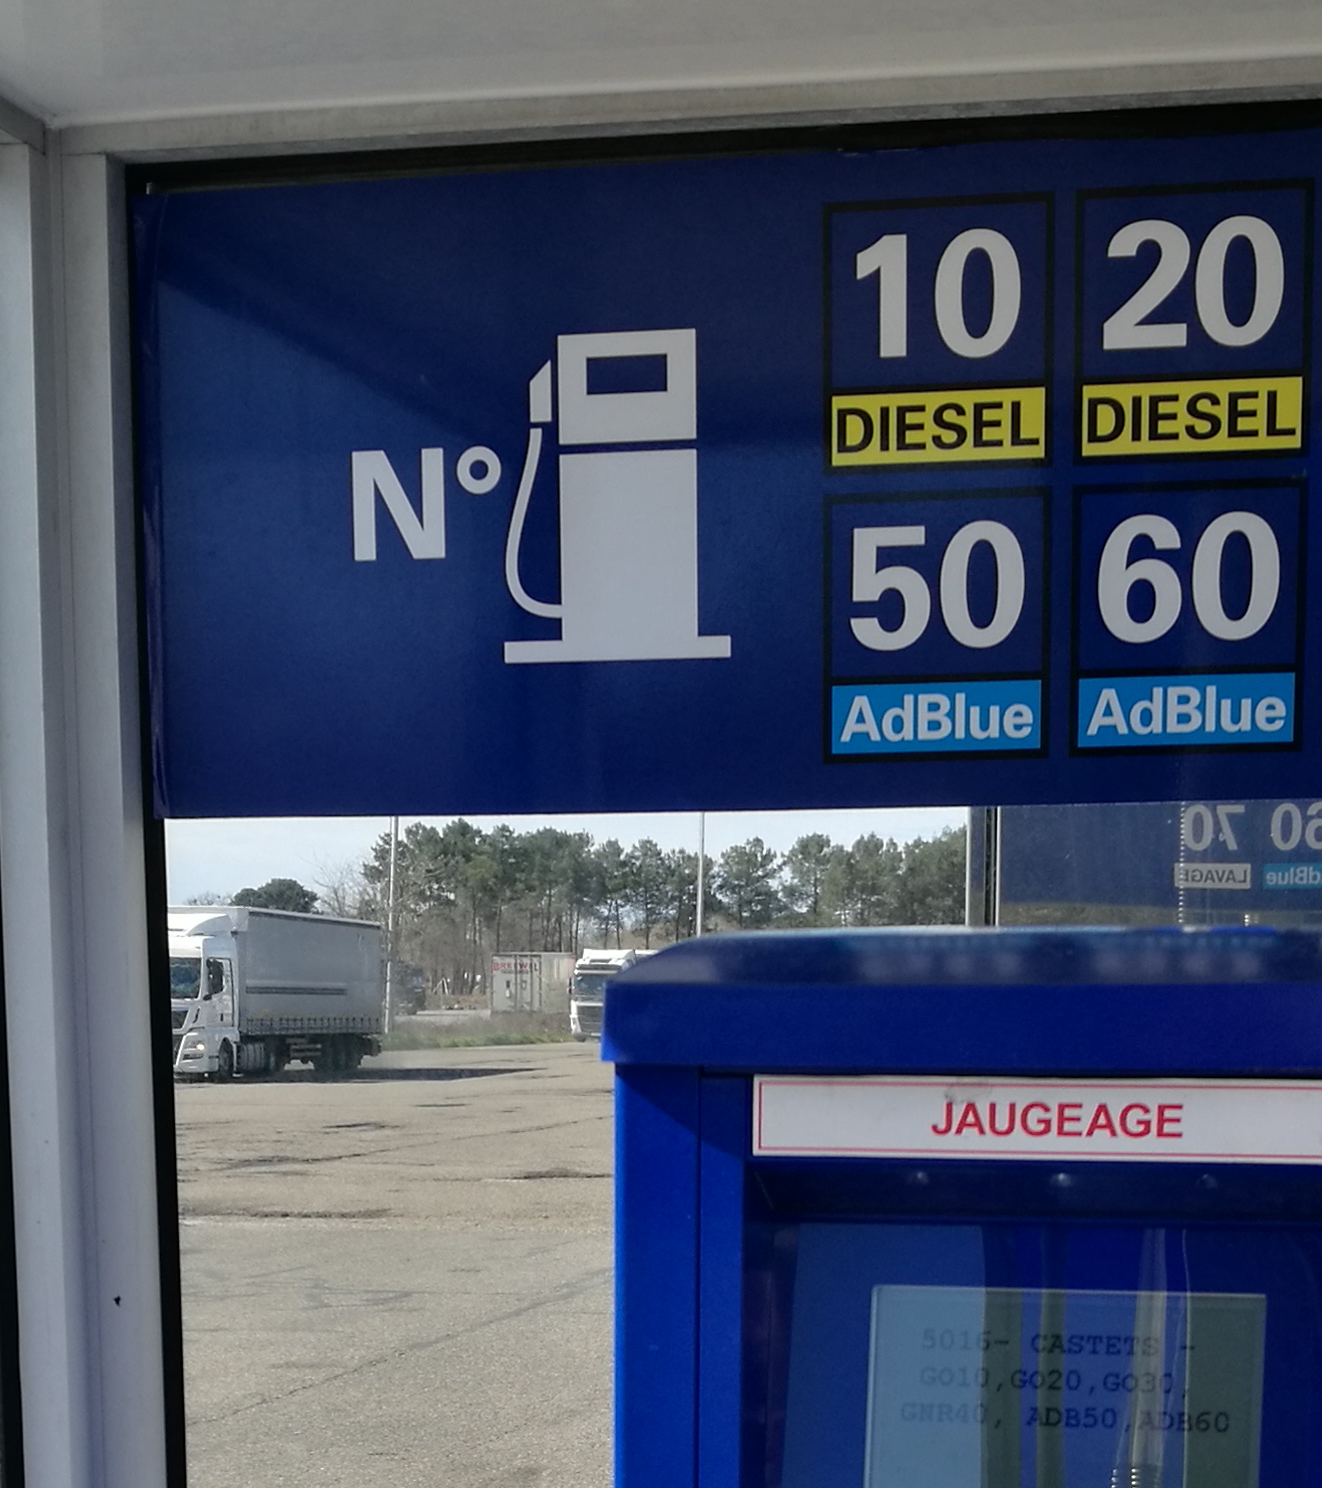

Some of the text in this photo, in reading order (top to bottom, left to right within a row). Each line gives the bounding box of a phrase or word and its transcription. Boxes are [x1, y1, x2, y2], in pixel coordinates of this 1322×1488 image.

[855, 228, 1021, 359] 10
[1101, 215, 1285, 350] 20
[836, 402, 1041, 454] DIESEL
[1086, 390, 1297, 444] DIESEL
[351, 446, 502, 562] N°
[849, 520, 1025, 651] 50
[1096, 511, 1281, 644] 60
[840, 695, 1034, 744] AdBlue
[1086, 688, 1286, 737] AdBlue
[931, 1101, 1184, 1139] JAUGEAGE
[1031, 1335, 1160, 1357] CASTETS
